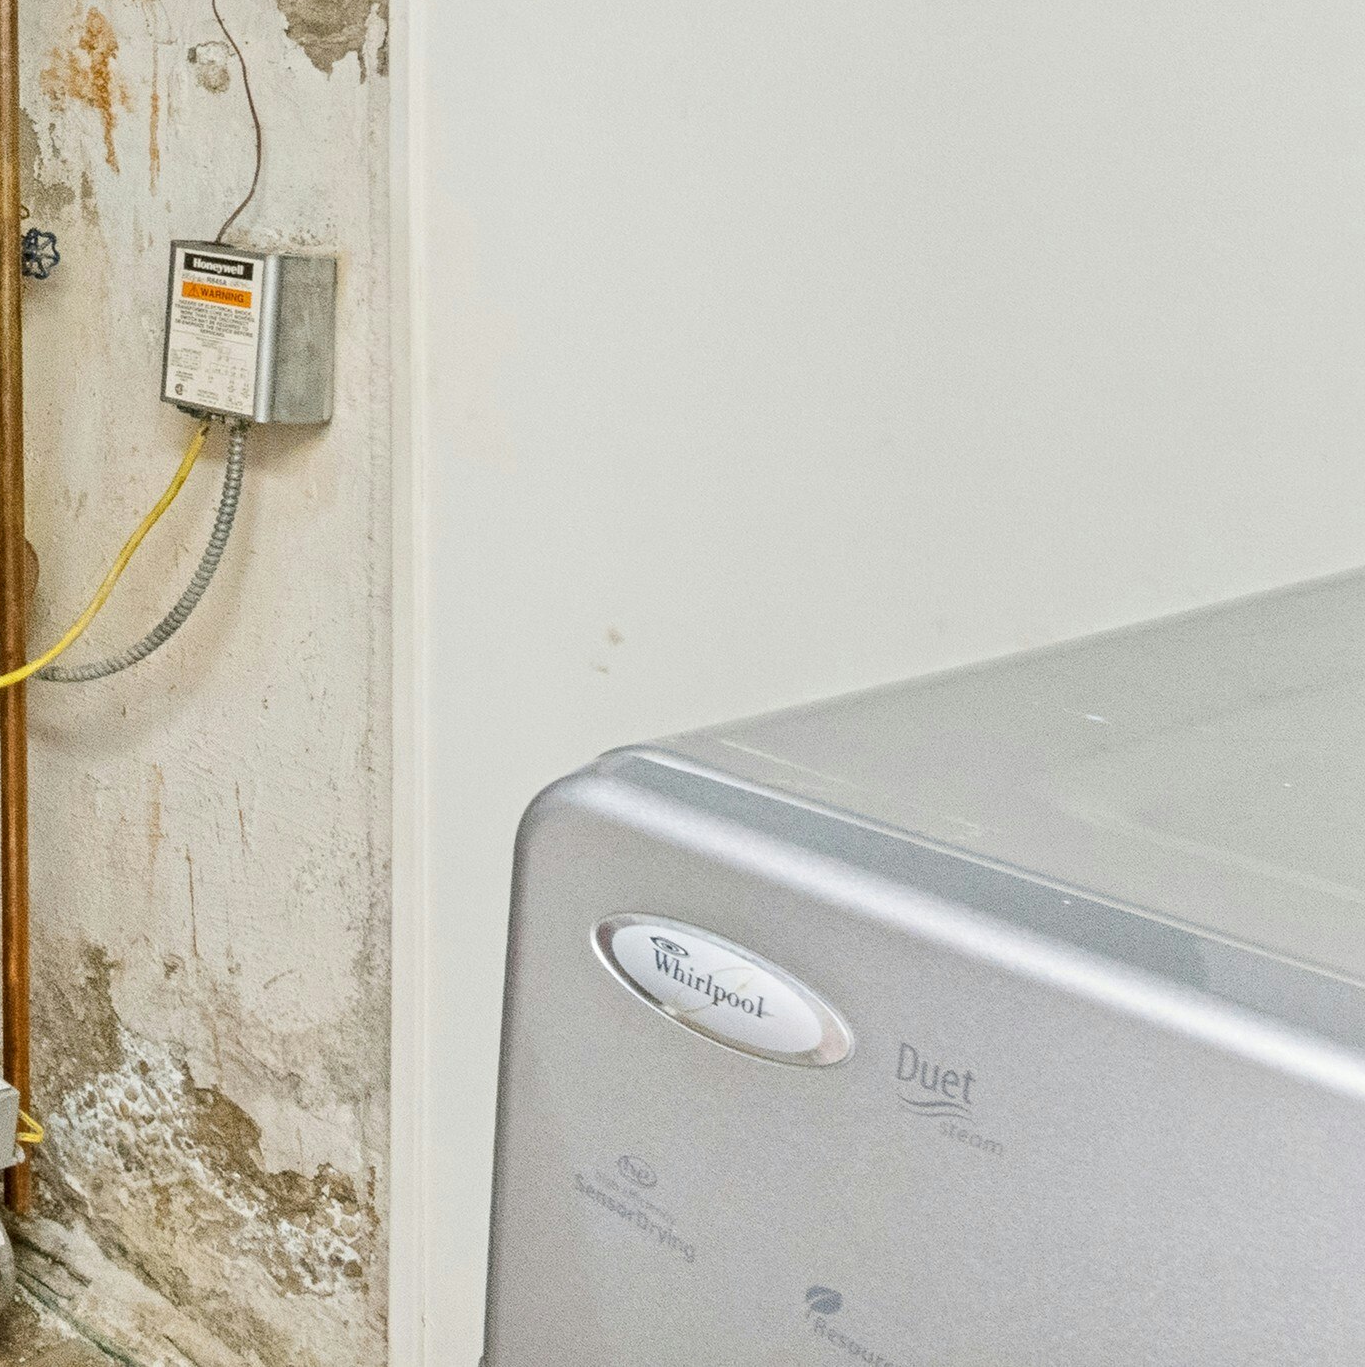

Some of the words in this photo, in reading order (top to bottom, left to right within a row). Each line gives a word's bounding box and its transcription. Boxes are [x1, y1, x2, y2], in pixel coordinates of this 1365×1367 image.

[192, 257, 245, 276] Honeywell
[200, 287, 245, 304] WARNING
[651, 947, 767, 1019] Whirlpool
[896, 1041, 977, 1104] Duet
[940, 1119, 1005, 1157] steam
[573, 1172, 696, 1264] SensorDrying
